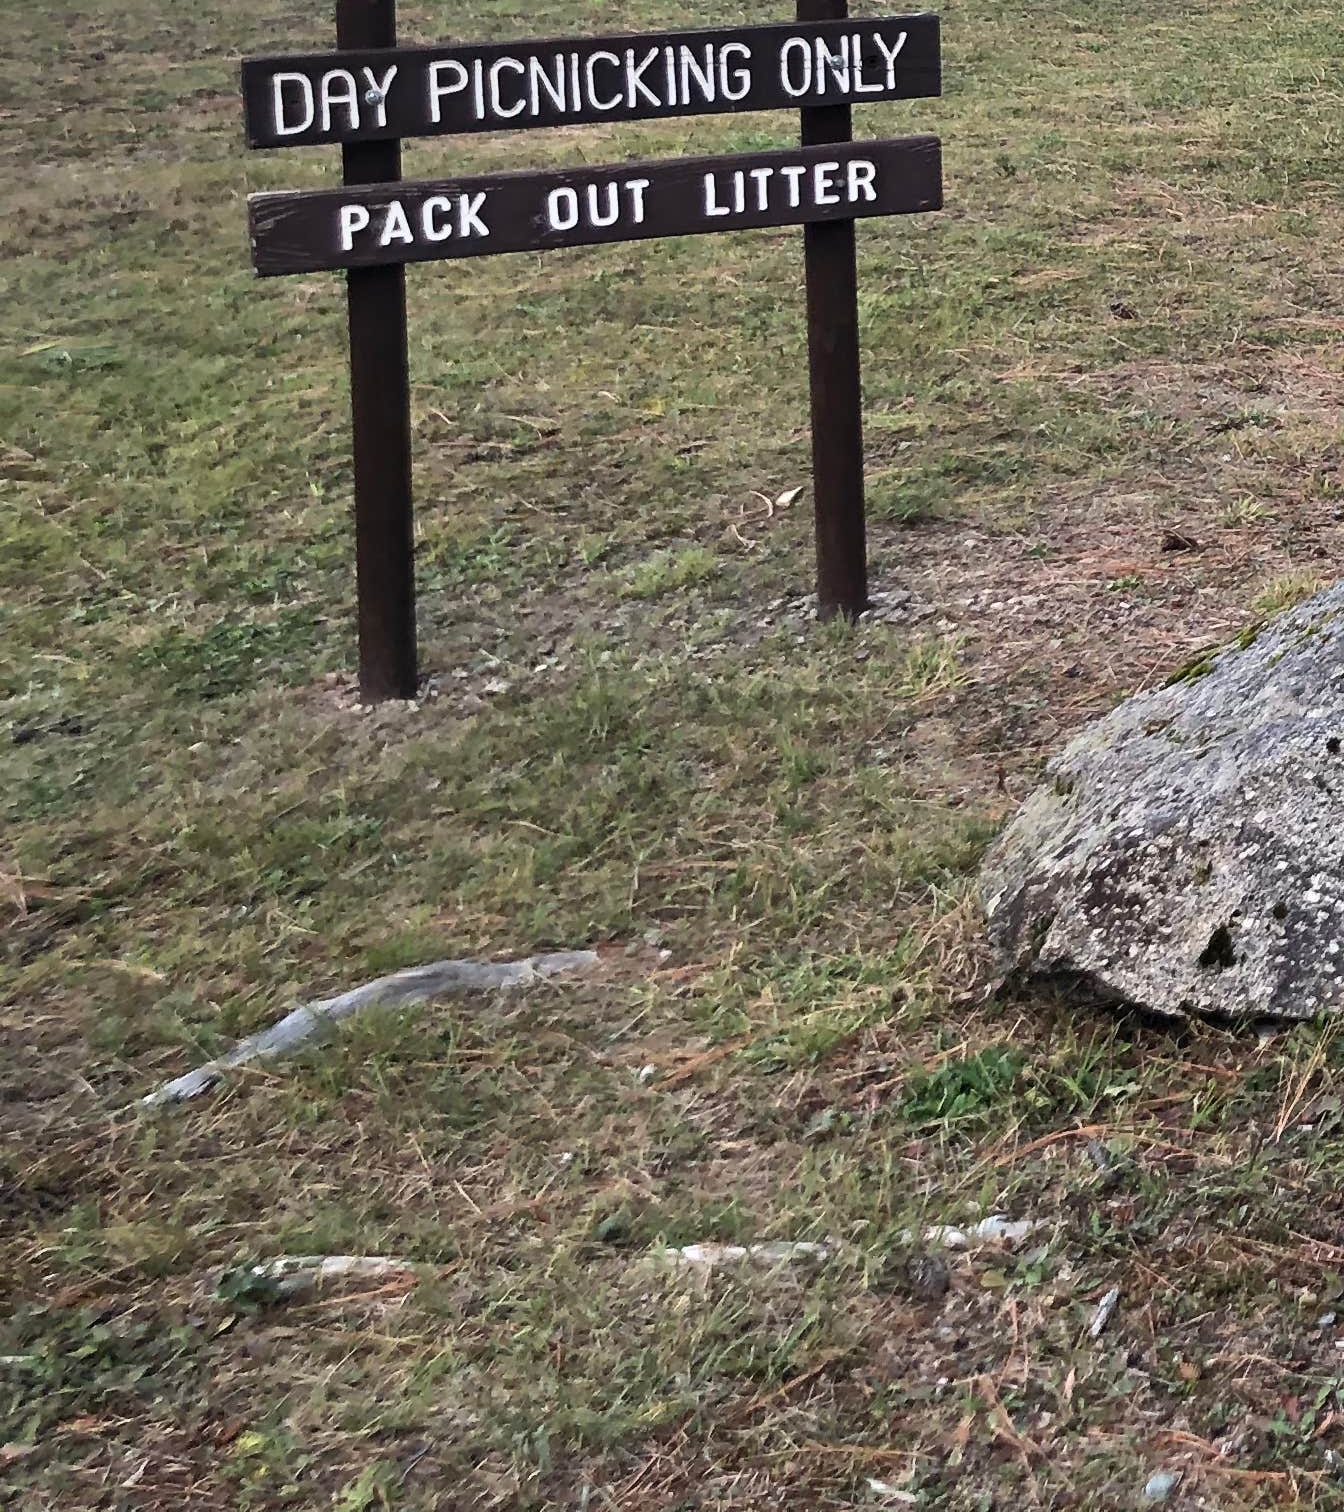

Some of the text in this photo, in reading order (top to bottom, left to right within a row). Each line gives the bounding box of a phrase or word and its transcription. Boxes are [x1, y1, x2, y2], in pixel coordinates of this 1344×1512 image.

[272, 31, 908, 136] DAY PICNICKING ONLY
[338, 160, 878, 251] PACK OUT LITTER
